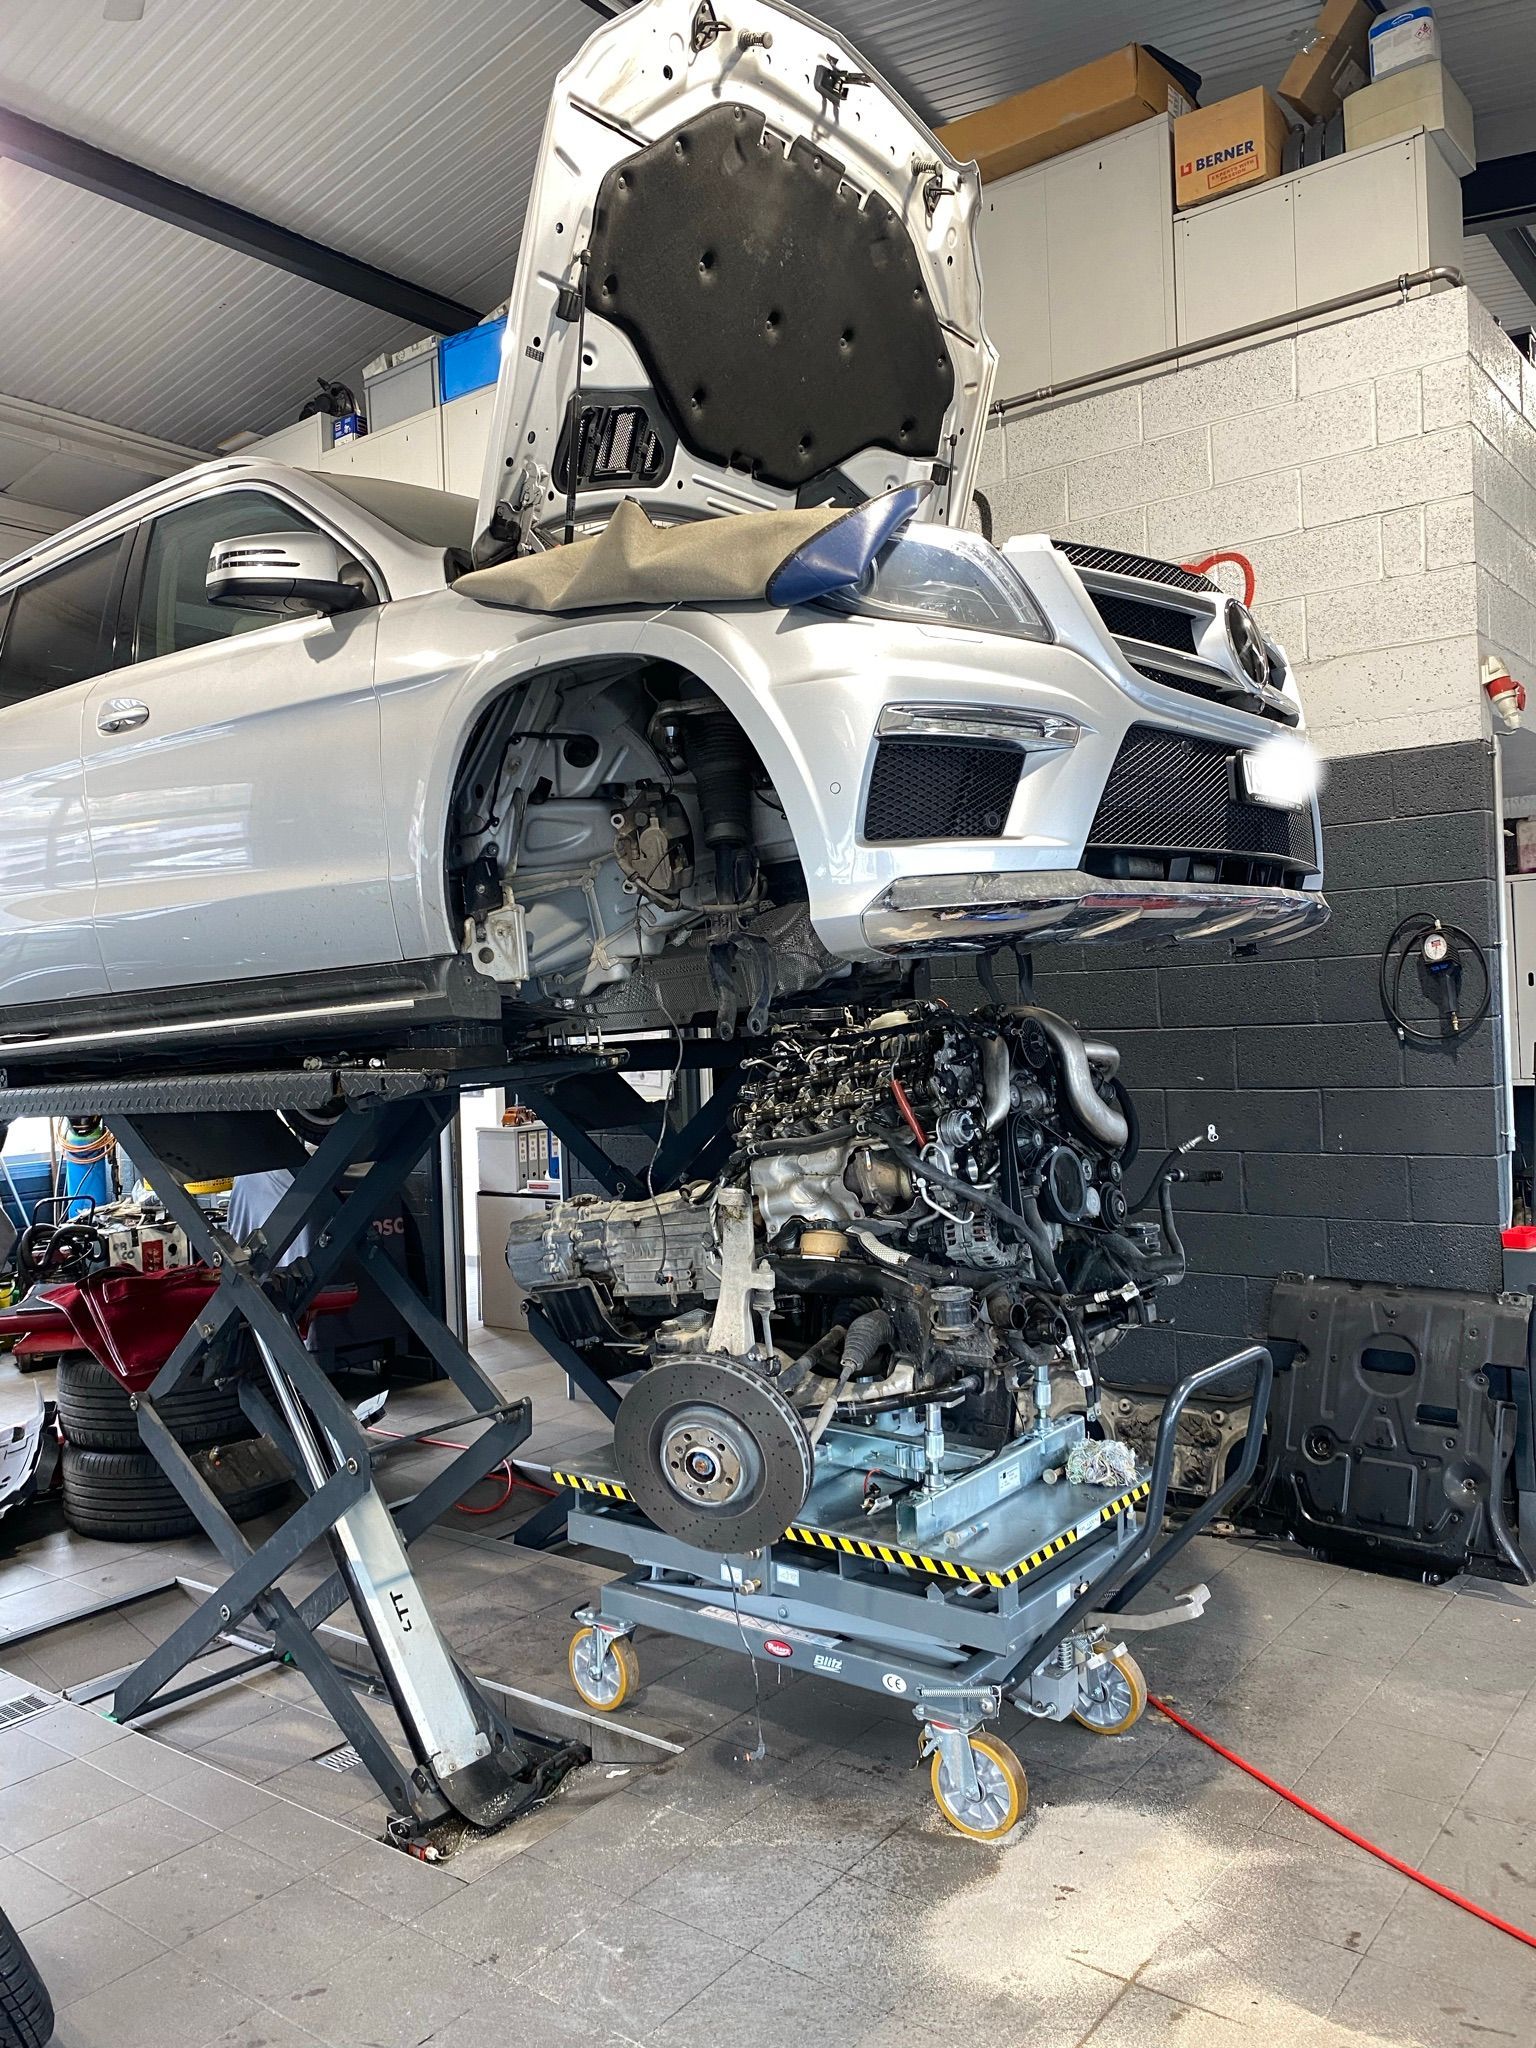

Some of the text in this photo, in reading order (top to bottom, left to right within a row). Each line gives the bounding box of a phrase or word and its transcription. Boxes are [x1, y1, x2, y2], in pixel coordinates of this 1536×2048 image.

[1196, 140, 1254, 171] BERNER
[814, 1655, 842, 1670] Blitz
[886, 1676, 902, 1690] CE
